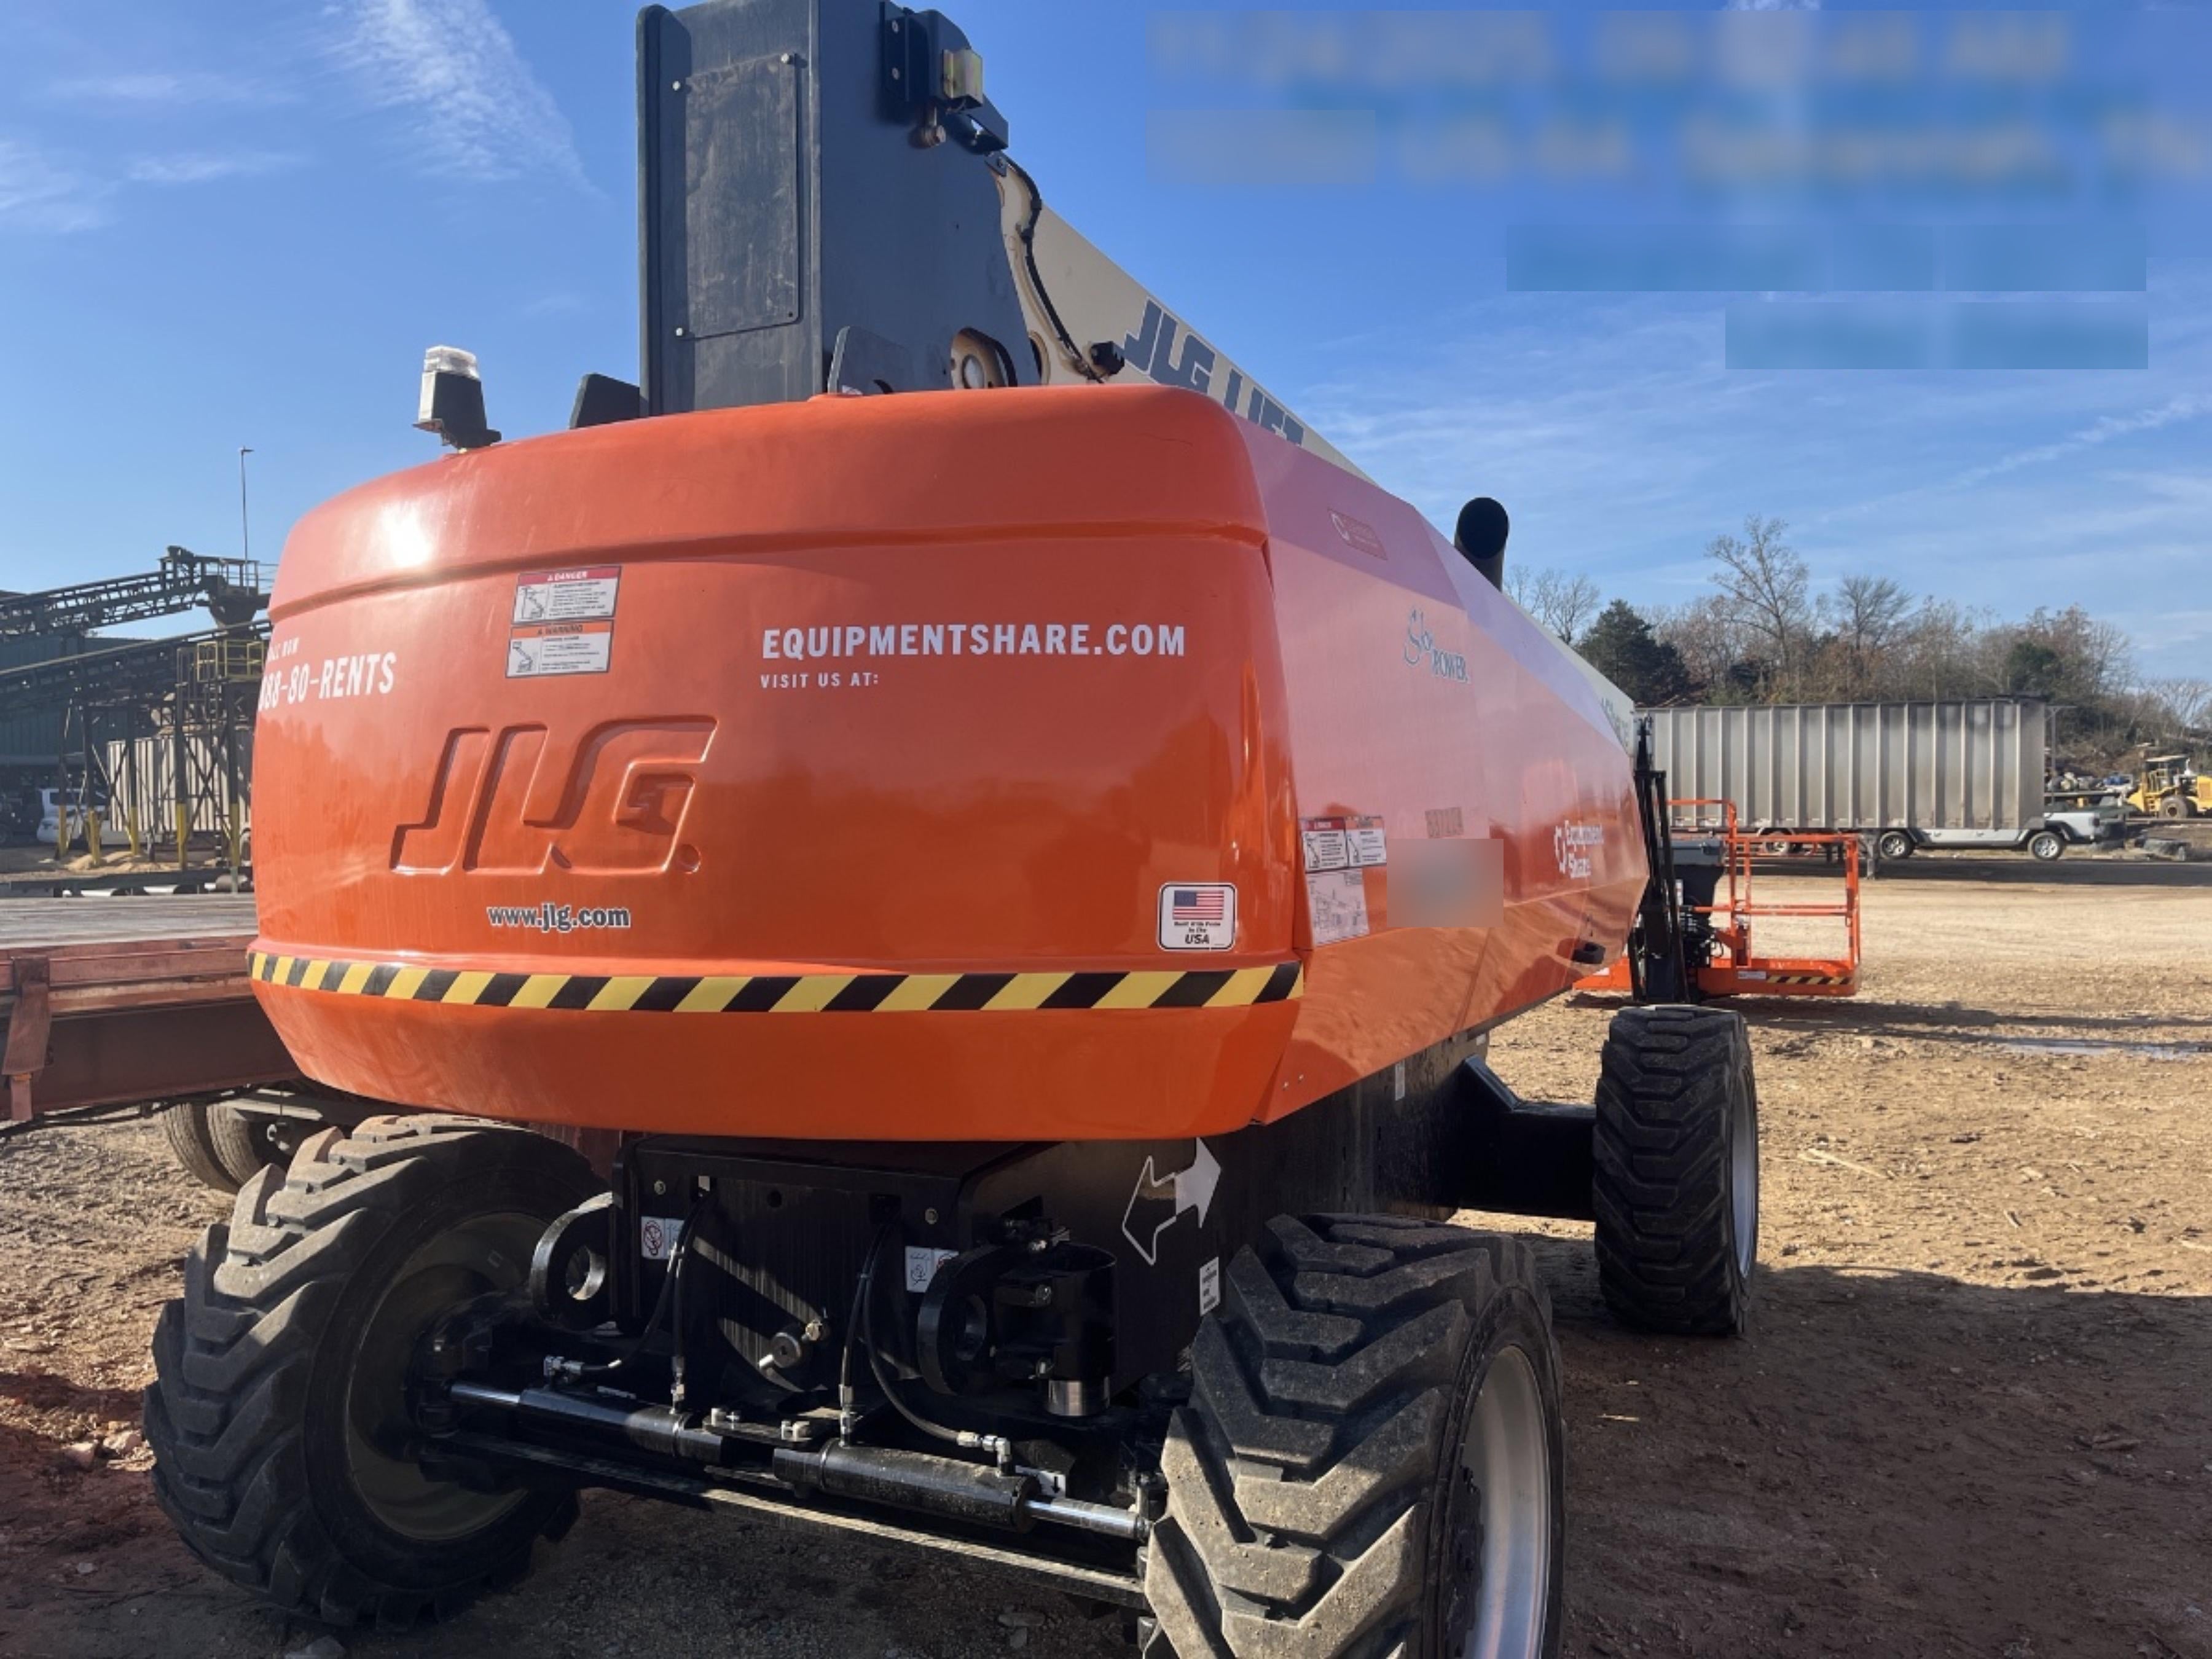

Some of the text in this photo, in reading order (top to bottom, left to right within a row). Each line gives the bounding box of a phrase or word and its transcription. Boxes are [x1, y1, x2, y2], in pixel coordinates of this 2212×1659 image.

[1111, 299, 1215, 395] JLG
[554, 571, 587, 581] DANGER
[762, 624, 1185, 661] EQUIPMENTSHARE.COM
[760, 672, 879, 688] VISIT US AT:
[391, 716, 719, 875] JLG
[486, 902, 631, 933] www.jlg.com
[1185, 934, 1210, 944] USA
